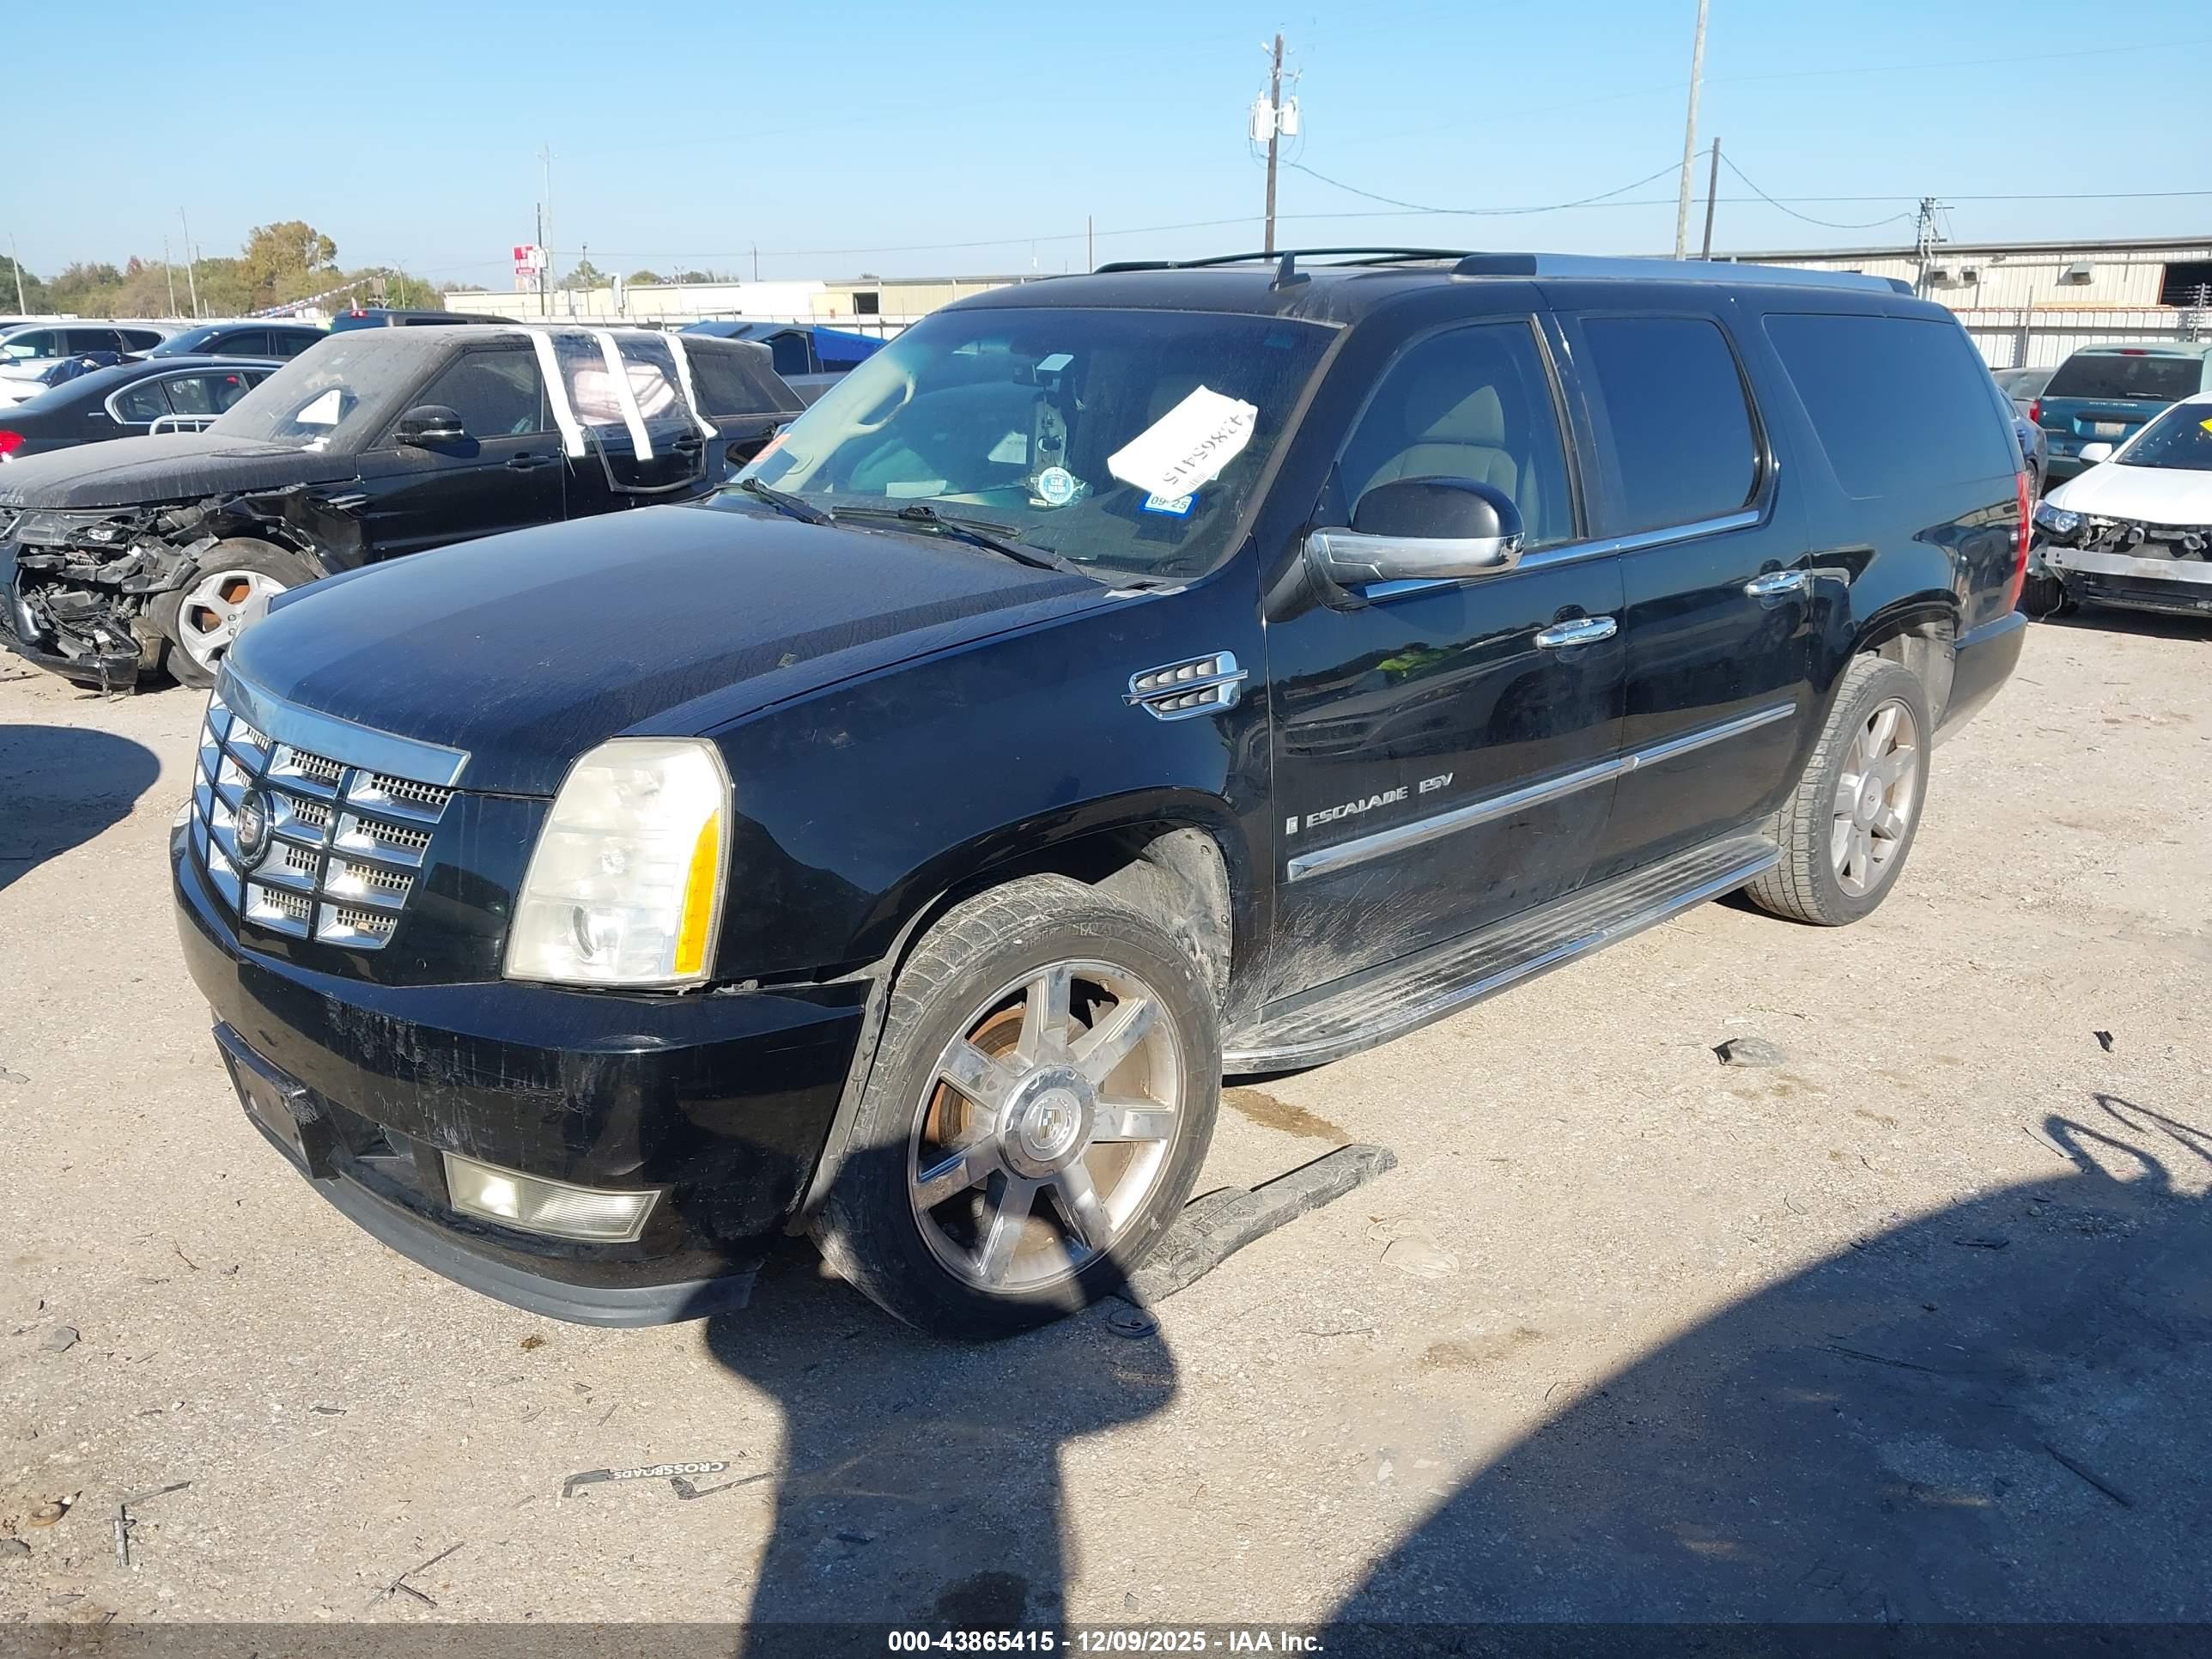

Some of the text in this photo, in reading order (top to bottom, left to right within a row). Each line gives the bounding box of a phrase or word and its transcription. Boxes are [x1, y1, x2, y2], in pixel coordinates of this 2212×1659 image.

[1162, 414, 1243, 485] 43865415
[1305, 772, 1454, 829] ESCALADE ESV
[613, 1461, 725, 1480] CROSSROADS
